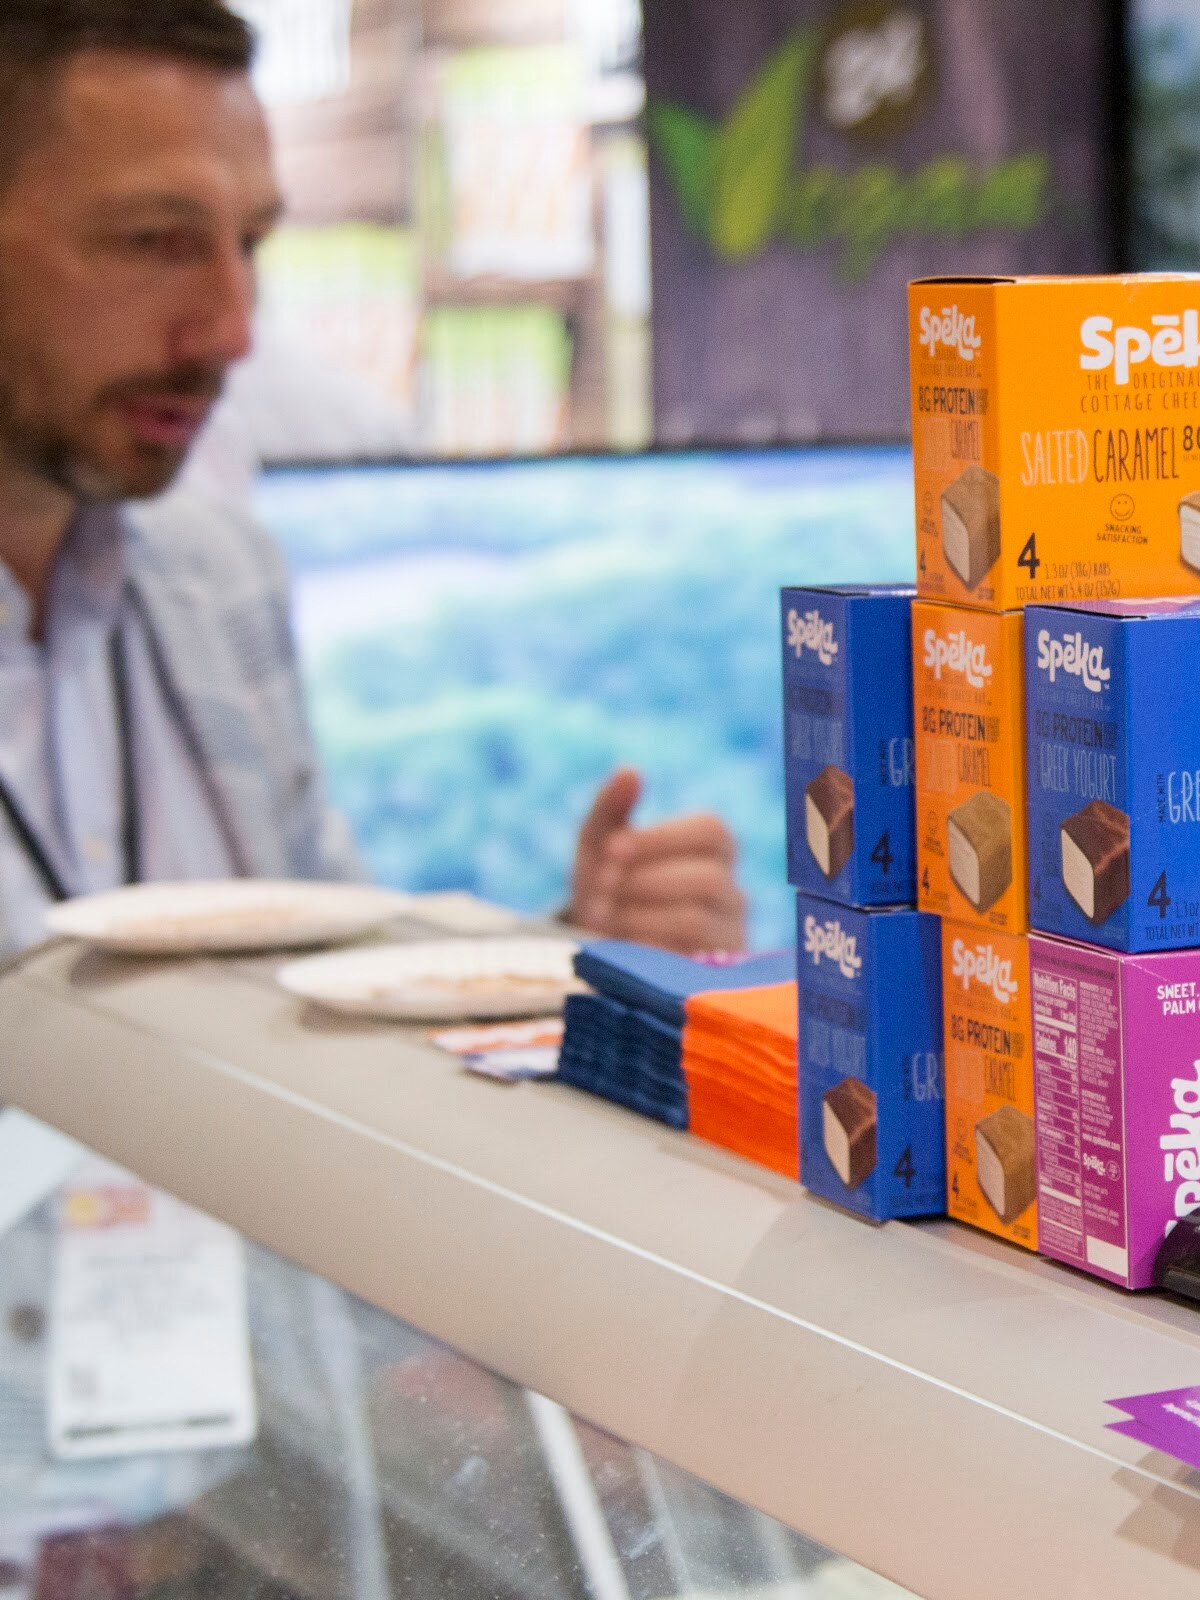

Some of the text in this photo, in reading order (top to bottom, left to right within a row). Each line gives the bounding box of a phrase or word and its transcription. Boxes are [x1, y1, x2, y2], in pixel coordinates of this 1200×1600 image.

[933, 386, 975, 415] PROTEIN
[1086, 374, 1108, 391] THE
[1080, 393, 1153, 413] COTTAGE
[1020, 426, 1180, 486] SALTED CARAMEL
[1017, 532, 1041, 579] 4
[939, 708, 986, 742] PROTEIN
[870, 831, 894, 876] 4
[1147, 869, 1172, 919] 4
[1163, 1000, 1196, 1015] PALM
[967, 1018, 1011, 1055] PROTEIN
[893, 1146, 915, 1189] 4
